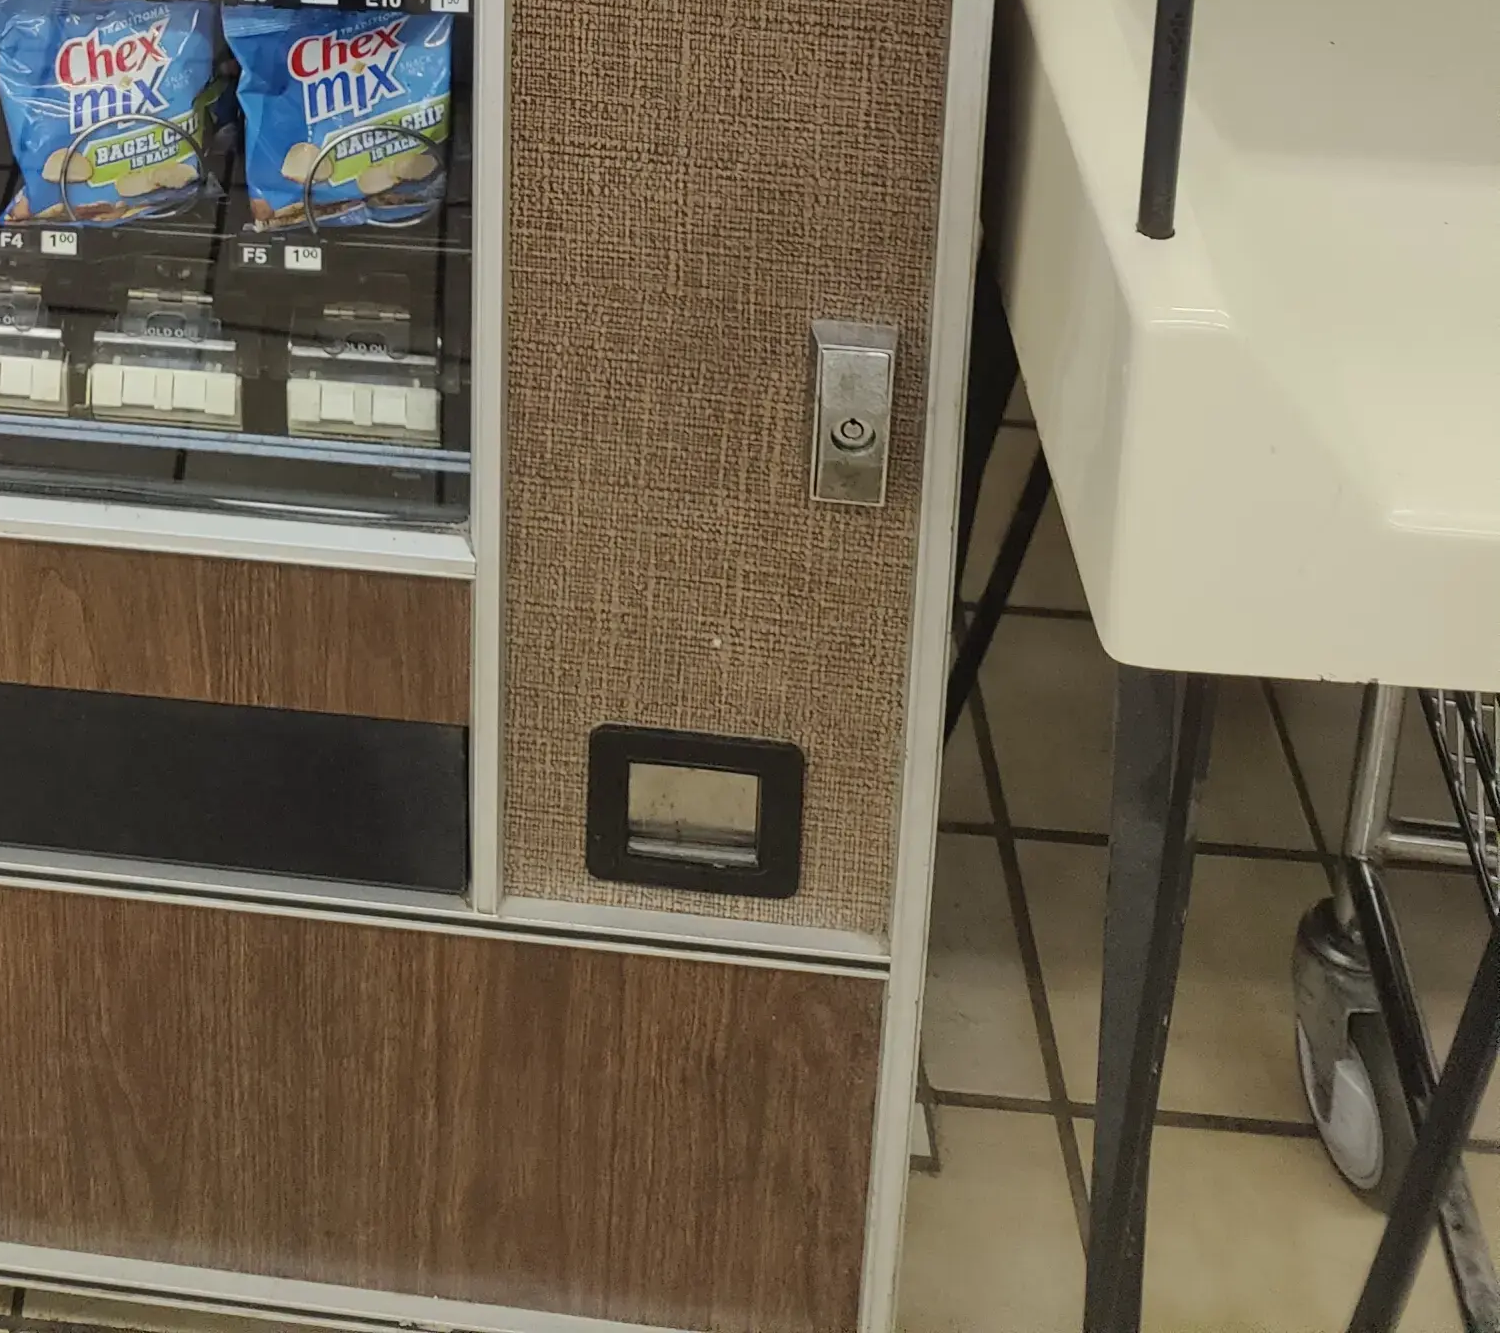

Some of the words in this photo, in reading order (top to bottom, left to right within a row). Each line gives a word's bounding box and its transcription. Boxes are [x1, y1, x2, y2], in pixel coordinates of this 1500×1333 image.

[59, 25, 164, 86] Chex
[291, 22, 404, 78] Chex
[74, 64, 164, 130] mix
[308, 50, 399, 120] mix
[96, 133, 161, 166] BAGEL
[0, 233, 24, 248] F4
[243, 248, 267, 264] F5
